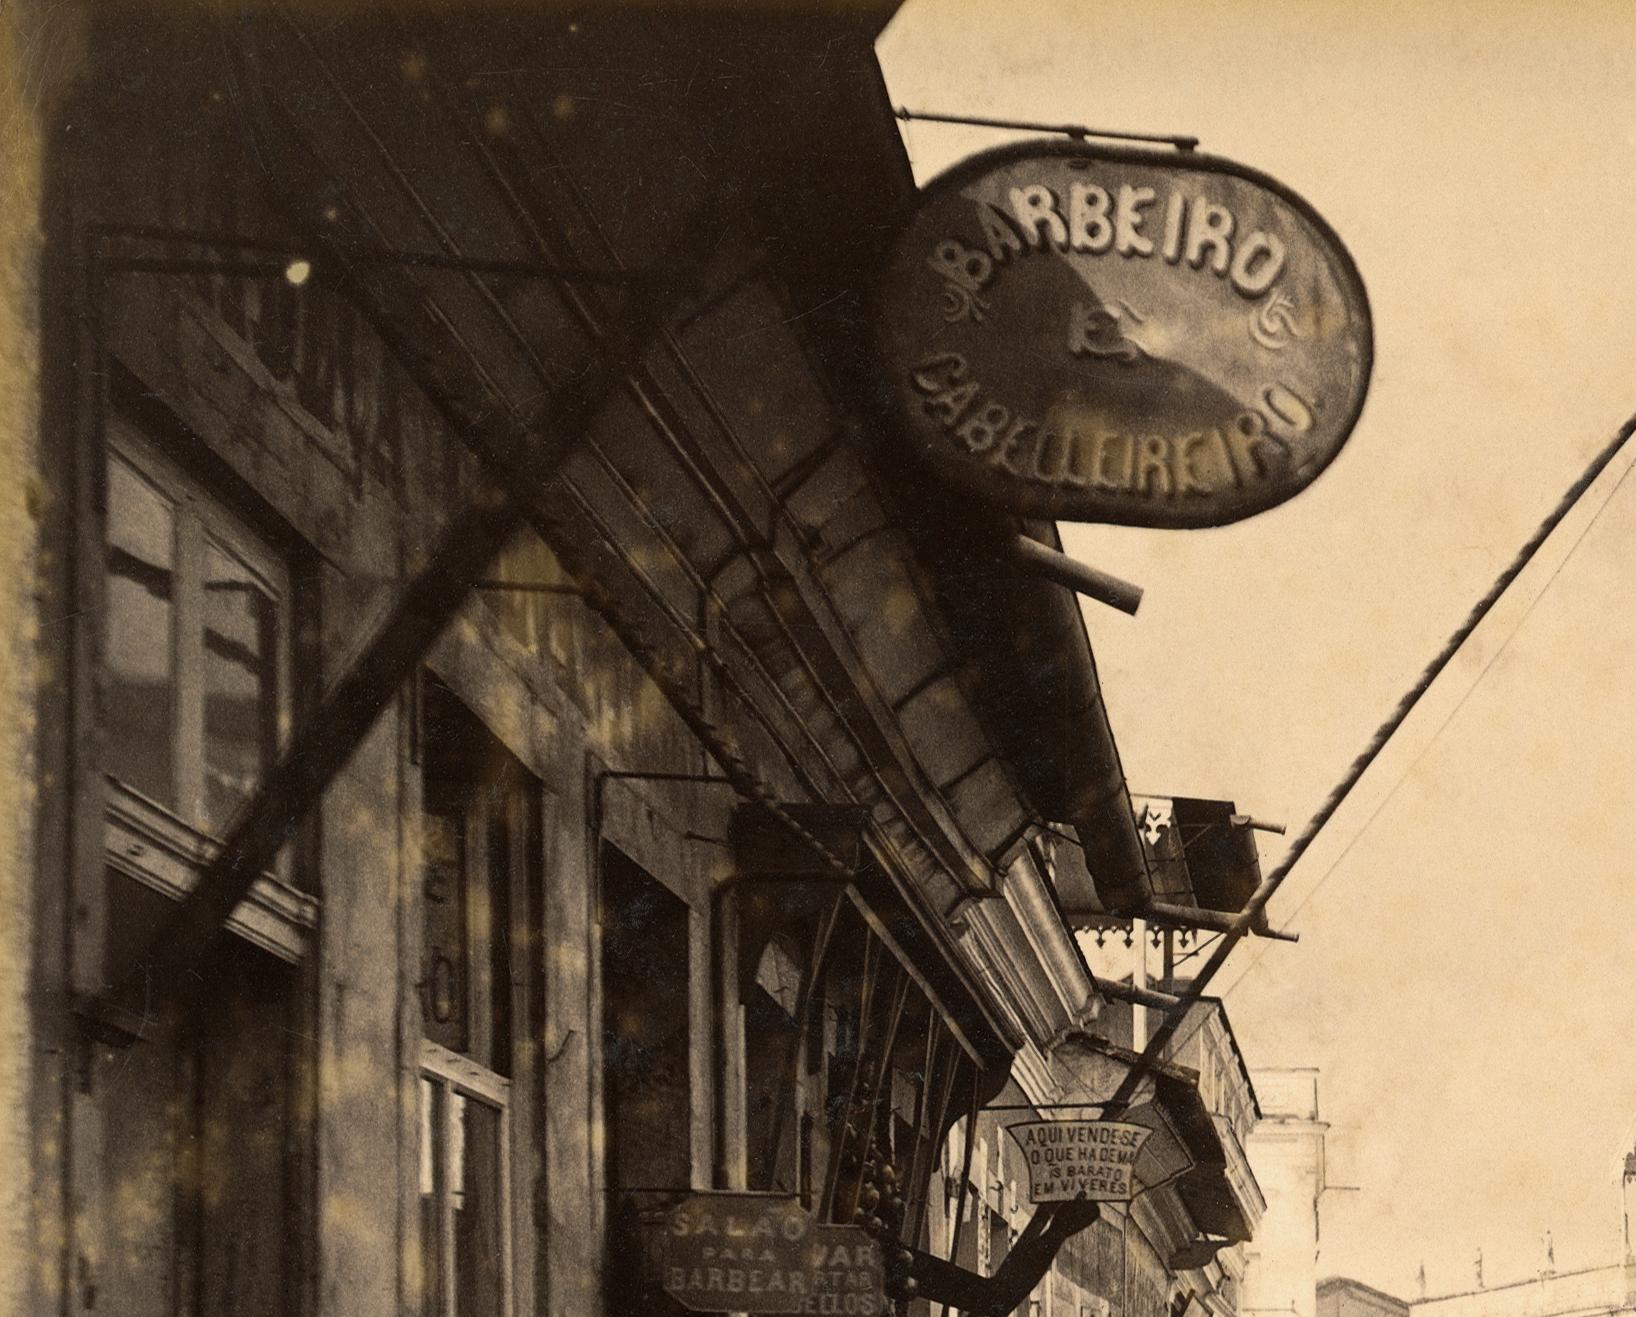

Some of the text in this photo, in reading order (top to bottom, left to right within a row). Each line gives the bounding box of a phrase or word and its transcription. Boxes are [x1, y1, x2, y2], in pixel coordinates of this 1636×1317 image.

[928, 181, 1286, 297] BARBEIRO
[910, 352, 1317, 496] CABELLEIREIRO
[1025, 1126, 1063, 1148] AQUI
[1030, 1149, 1041, 1165] O
[1044, 1147, 1073, 1167] QUE
[1066, 1165, 1123, 1182] BARATO
[1034, 1178, 1127, 1196] EM VIVERES
[702, 1247, 777, 1262] PARA
[670, 1266, 806, 1292] BARBEAR
